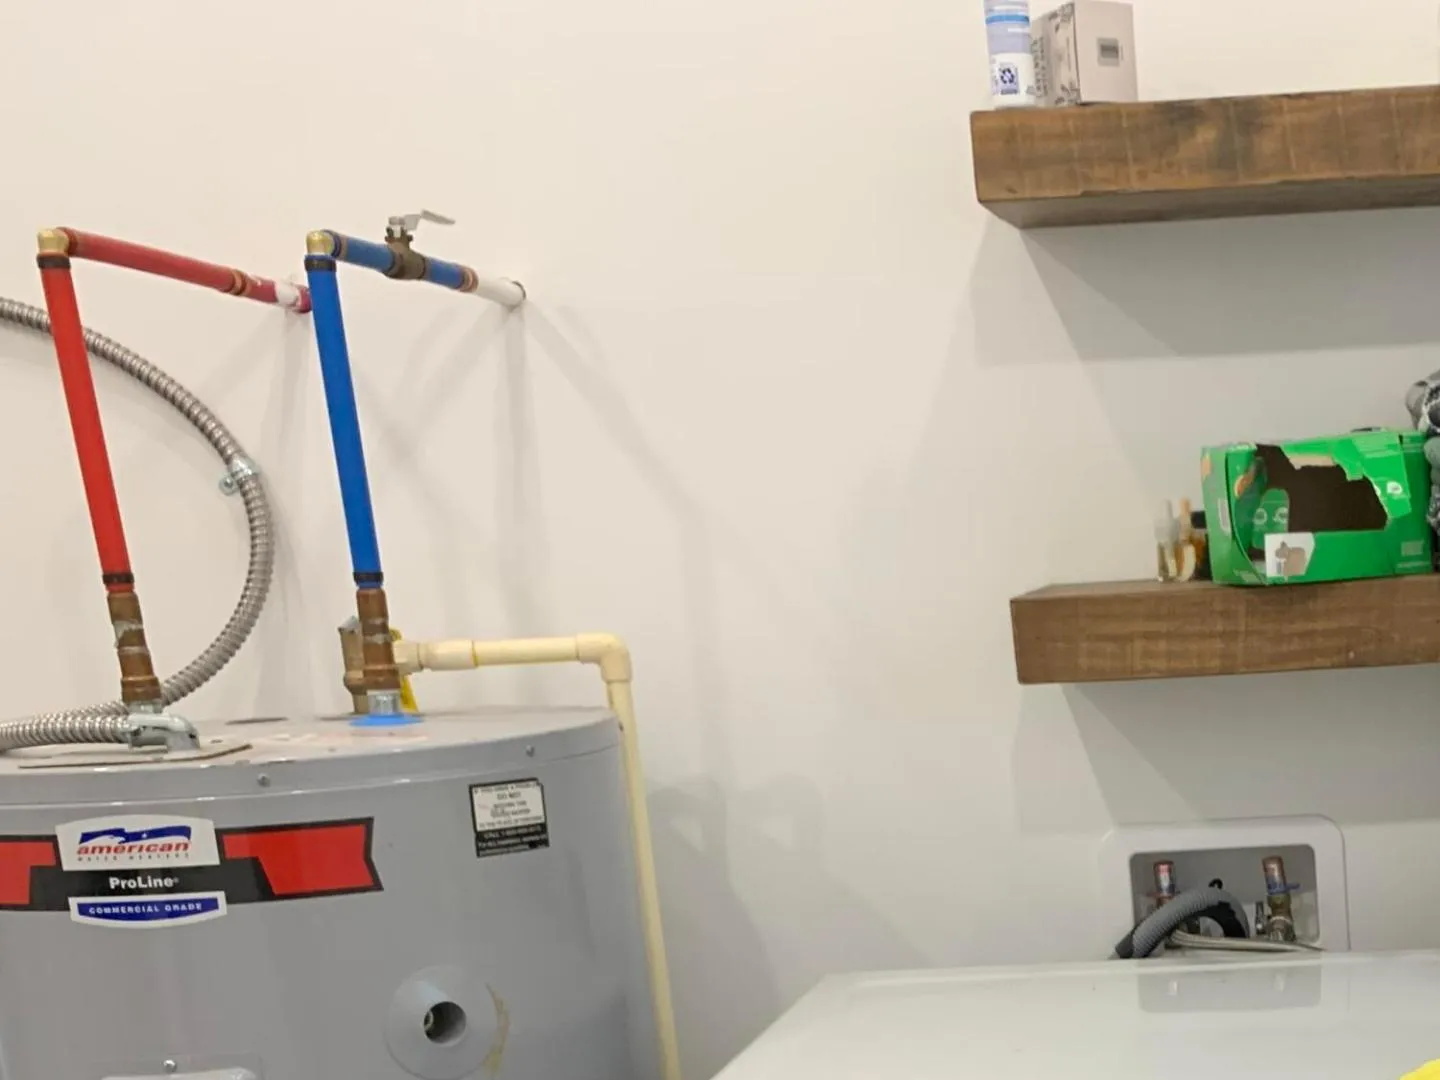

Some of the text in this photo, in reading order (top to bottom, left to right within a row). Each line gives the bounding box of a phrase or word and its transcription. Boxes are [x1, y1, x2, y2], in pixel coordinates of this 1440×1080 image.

[77, 842, 190, 856] american
[88, 902, 202, 915] COMMERCIAL GRADE
